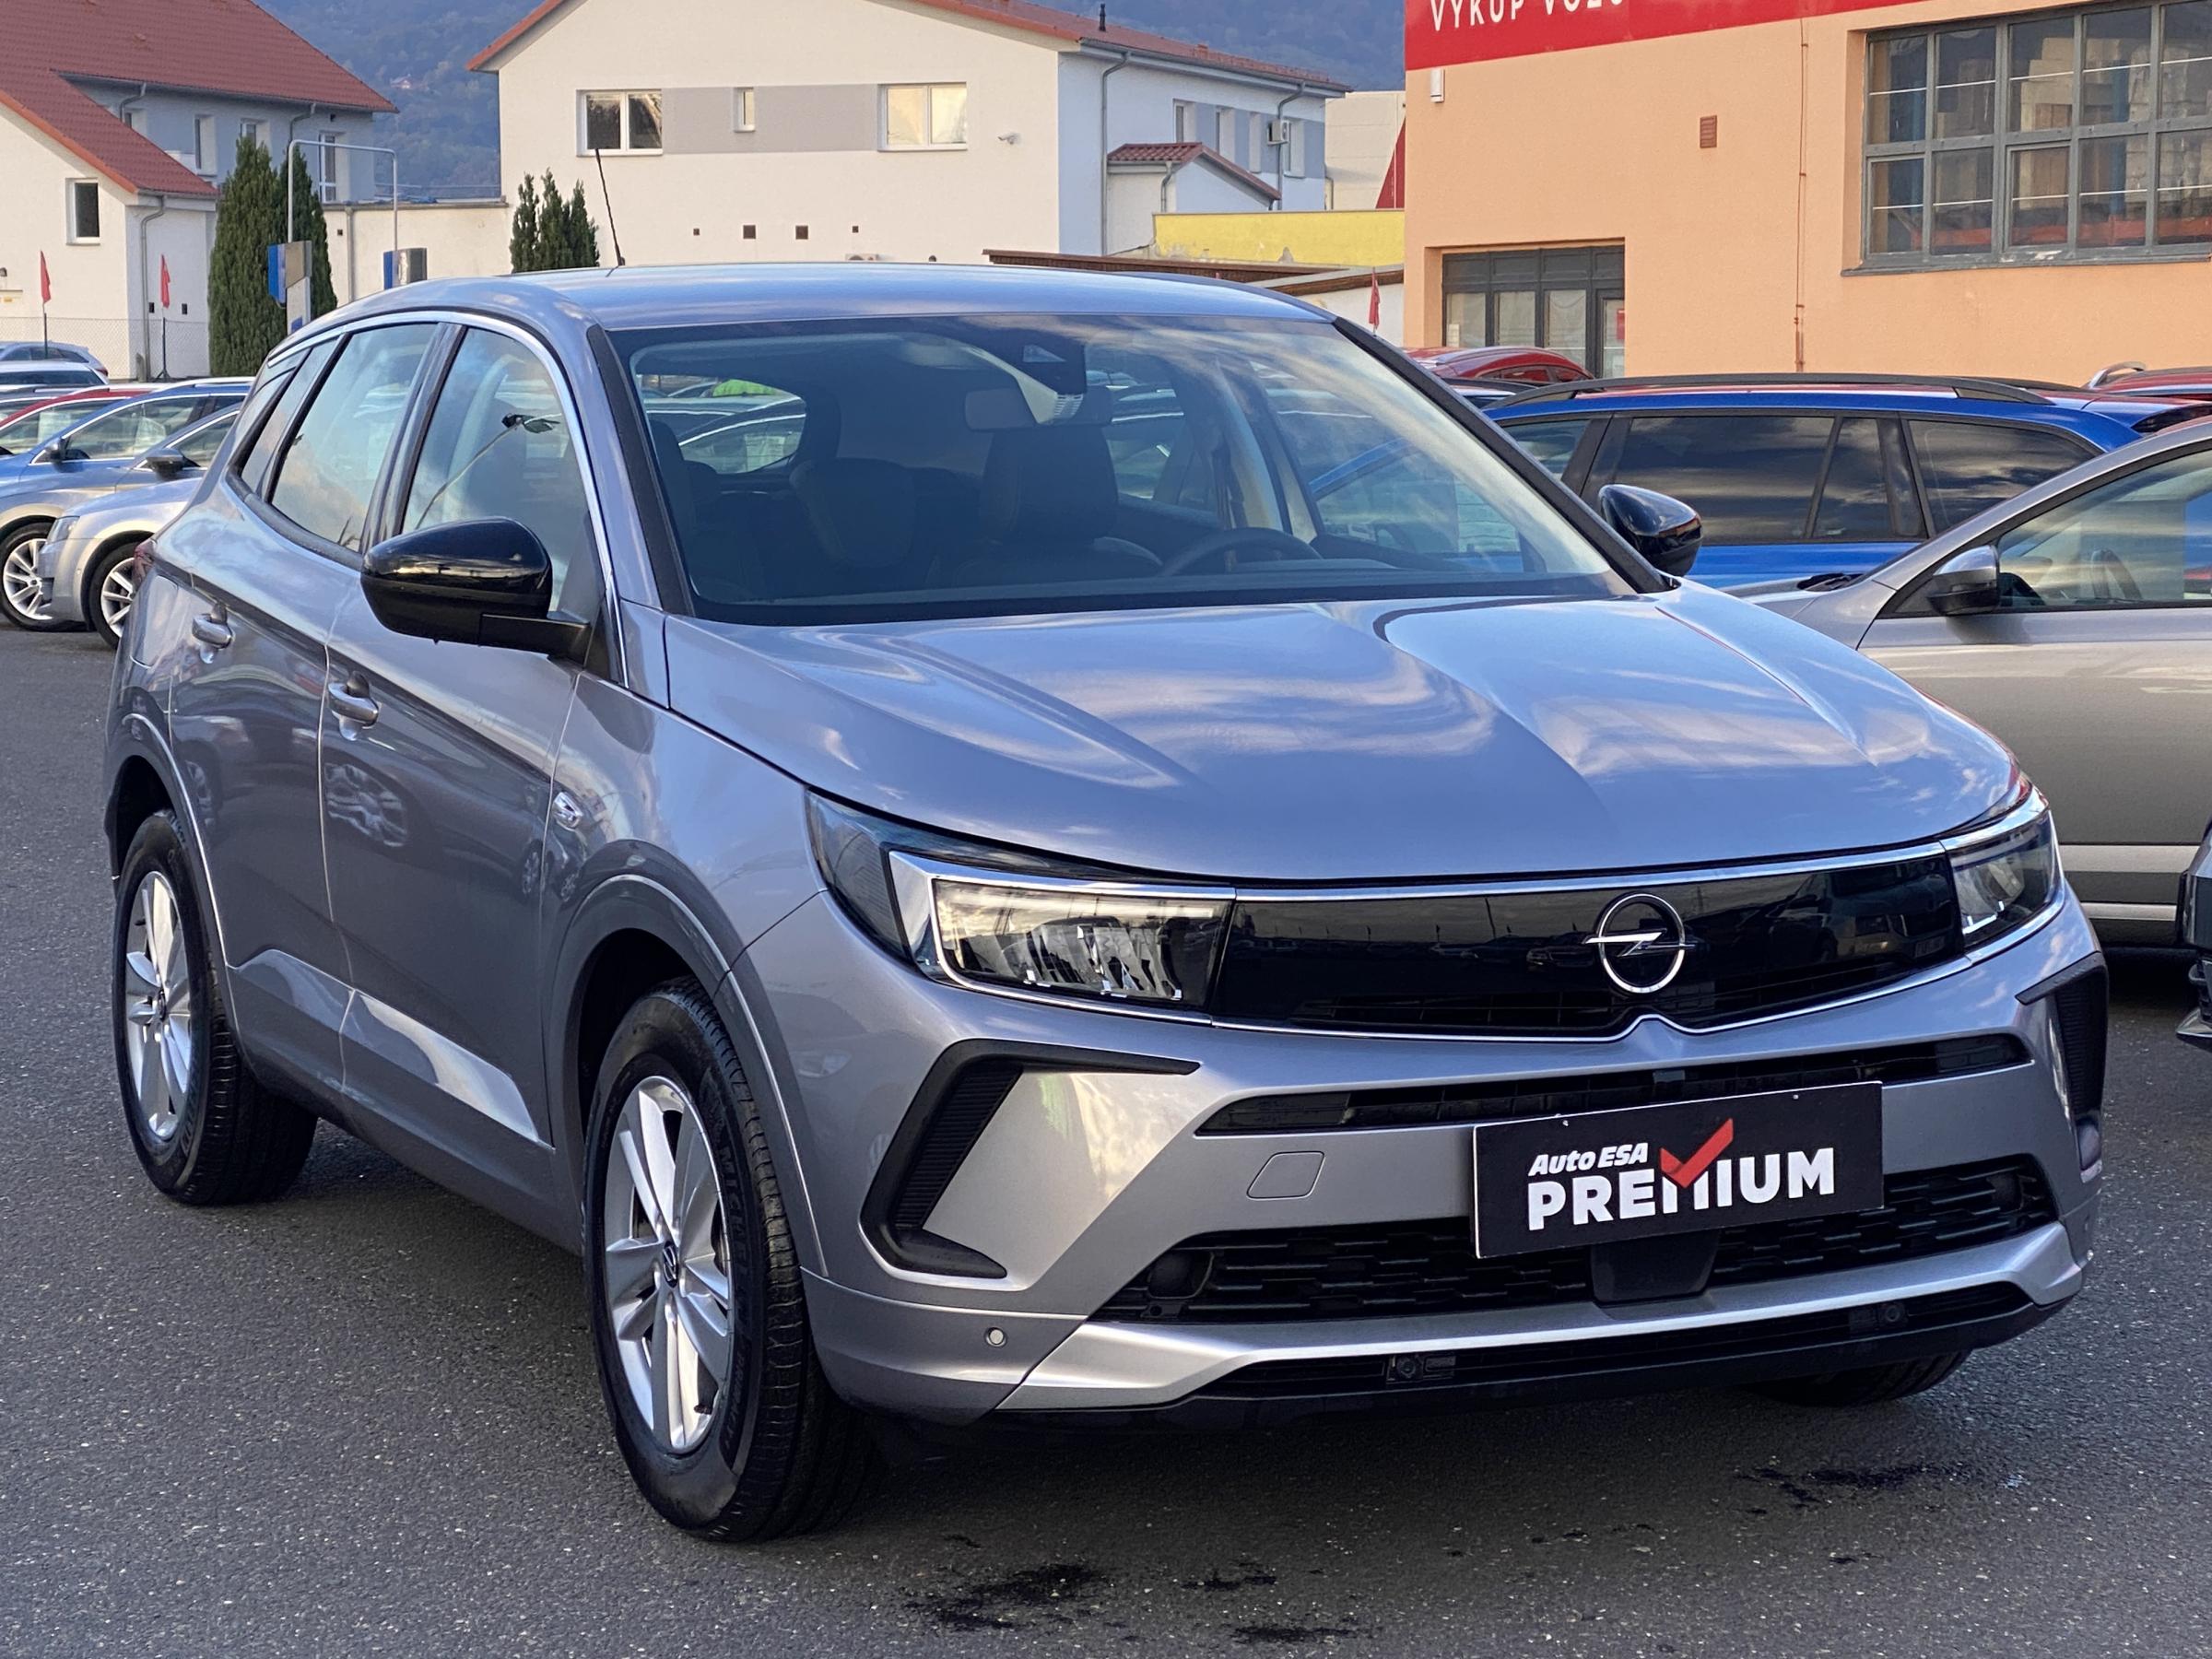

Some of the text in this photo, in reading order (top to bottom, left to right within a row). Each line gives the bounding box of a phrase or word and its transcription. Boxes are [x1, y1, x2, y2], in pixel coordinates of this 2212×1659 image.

[1527, 1142, 1649, 1177] Auto ESA
[1527, 1147, 1835, 1231] PREMIUM
